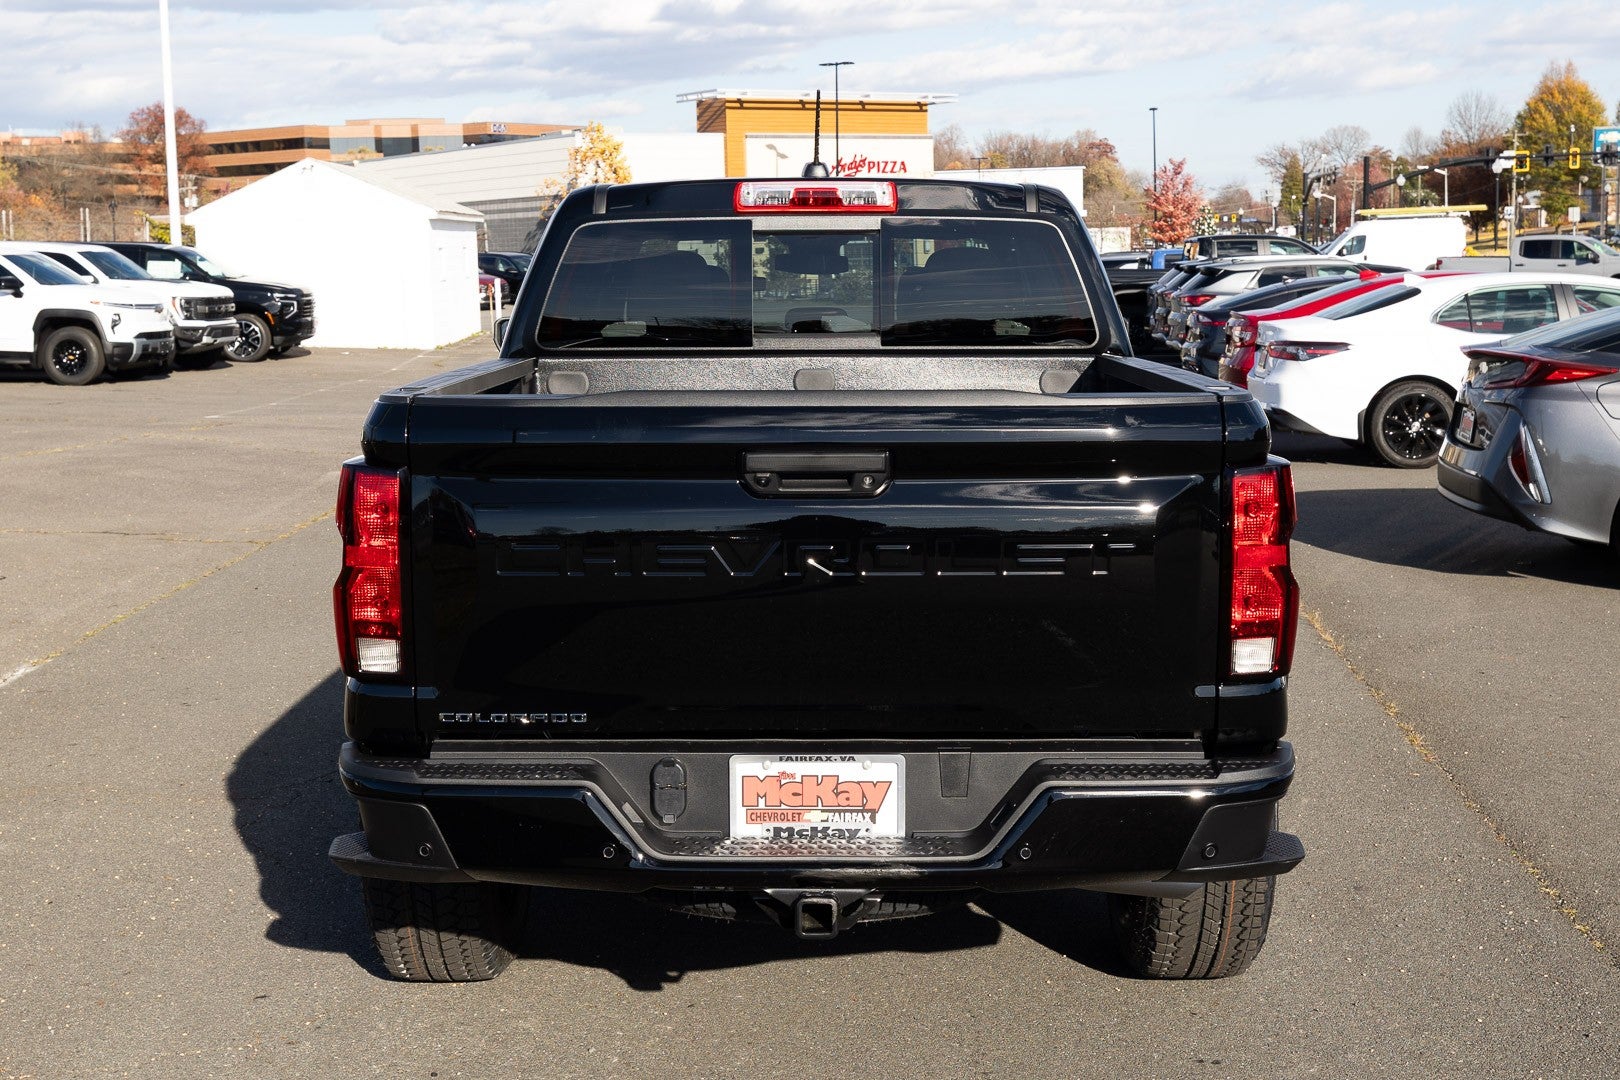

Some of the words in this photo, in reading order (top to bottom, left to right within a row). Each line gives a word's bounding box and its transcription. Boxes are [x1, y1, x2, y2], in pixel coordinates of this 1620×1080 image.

[867, 160, 908, 174] PIZZA
[495, 540, 1137, 577] CHEVROLET
[438, 712, 587, 723] COLORADO
[741, 774, 893, 814] McKay
[749, 811, 802, 822] CHEVROLET
[828, 812, 872, 823] FAIRFAX
[772, 826, 862, 838] McKay
